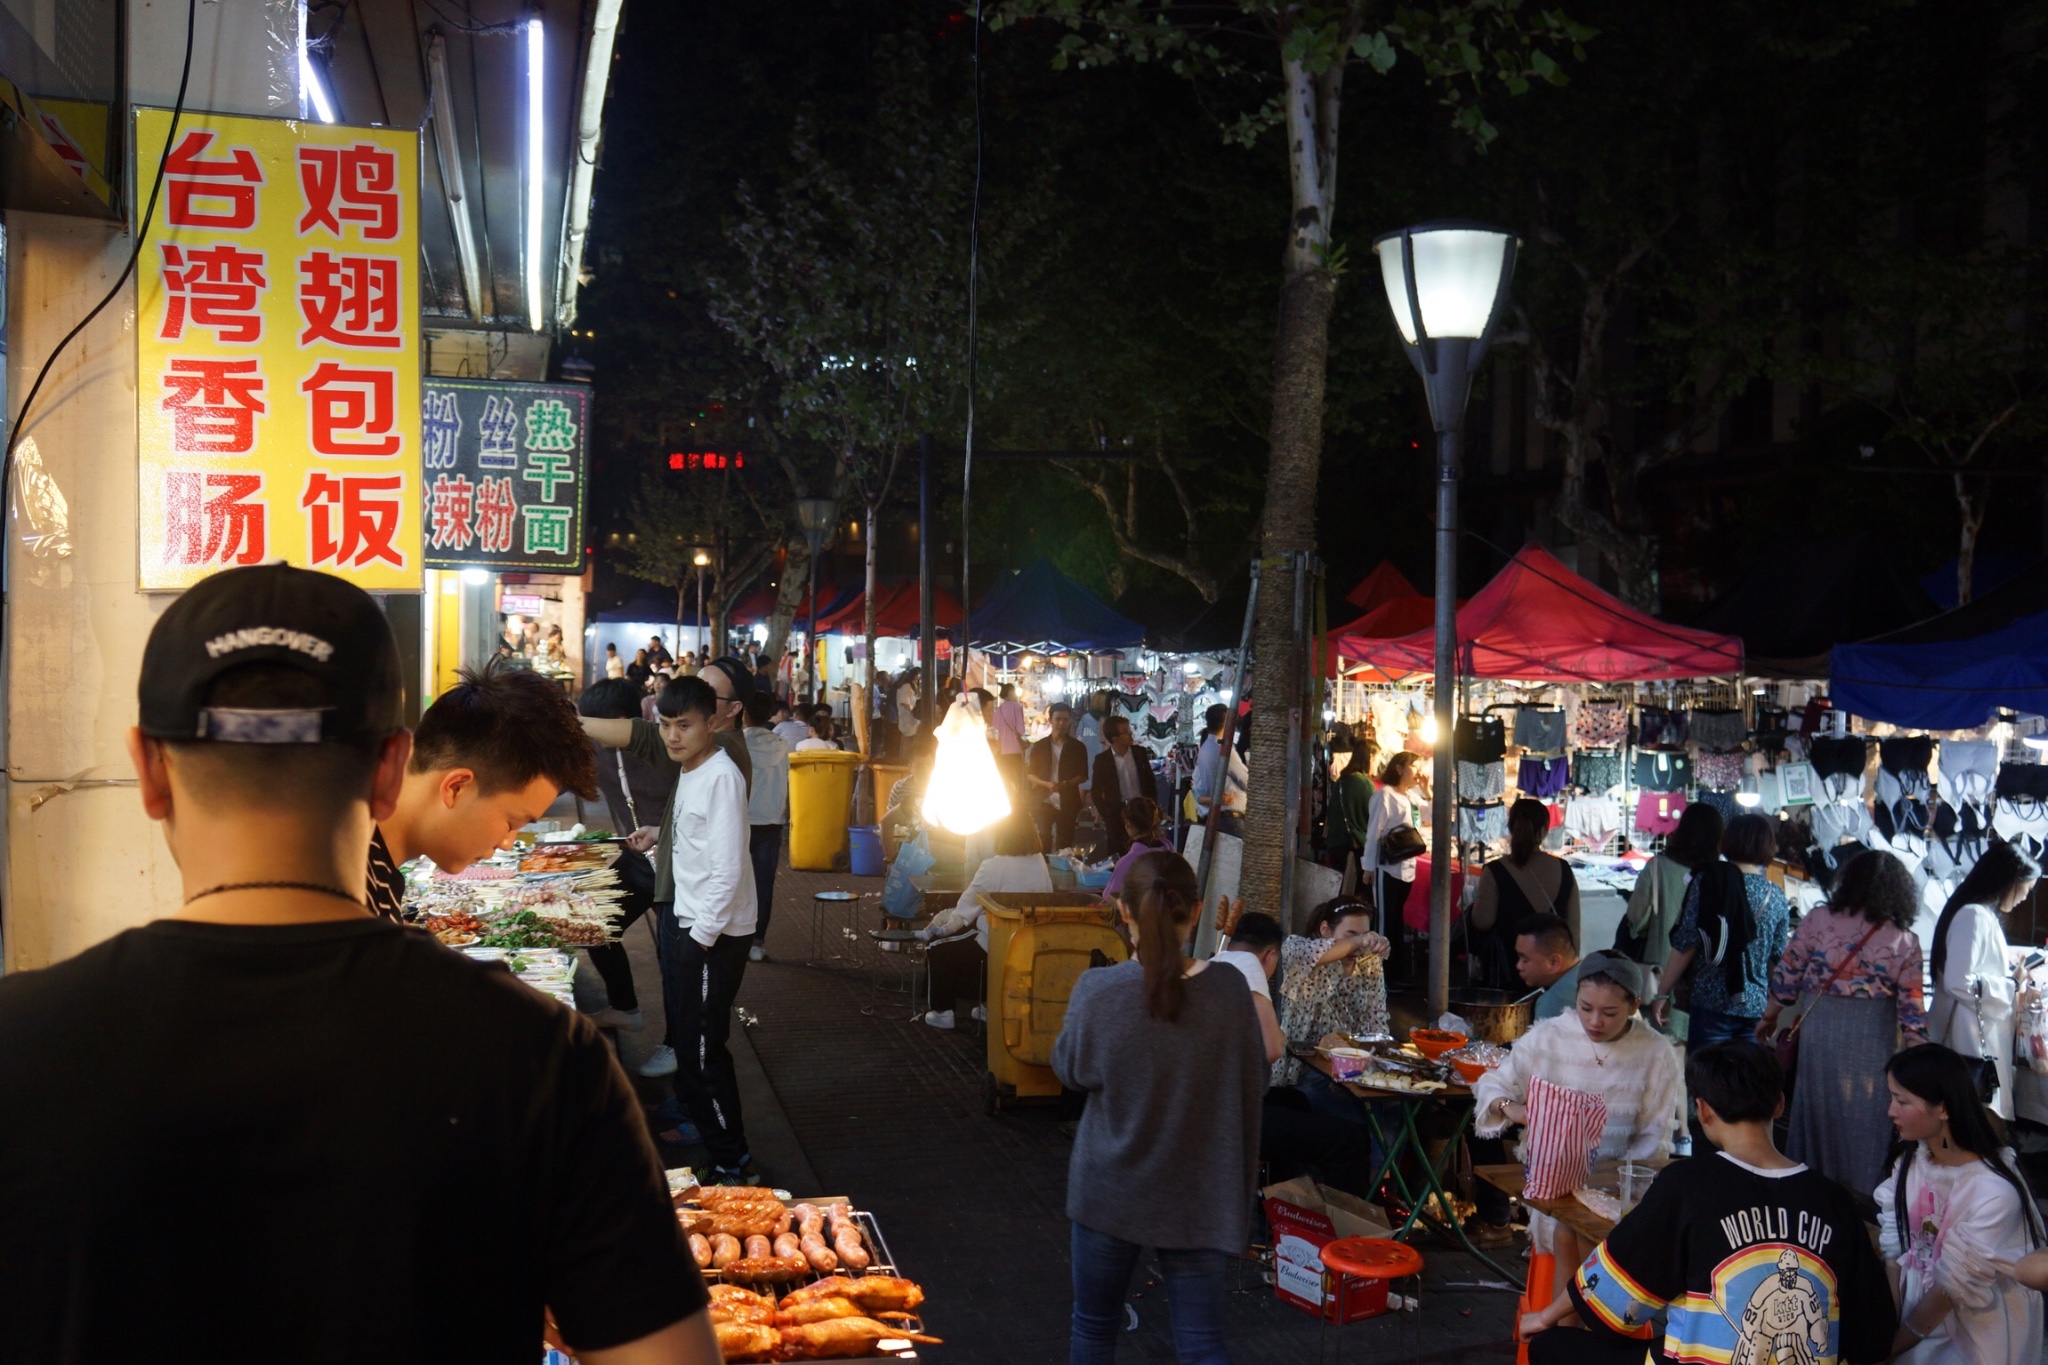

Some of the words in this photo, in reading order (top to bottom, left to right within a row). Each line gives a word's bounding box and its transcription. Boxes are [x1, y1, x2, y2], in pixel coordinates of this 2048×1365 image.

[160, 131, 267, 566] 台湾香肠
[299, 144, 403, 568] 鸡翅包饭
[522, 399, 577, 555] 热干面
[424, 472, 517, 552] 辣粉
[205, 626, 335, 662] HANGOVER
[1273, 1203, 1328, 1229] Budweiser
[1719, 1205, 1789, 1250] WORLD
[1797, 1209, 1833, 1255] CUP
[1280, 1265, 1320, 1288] Budweiser
